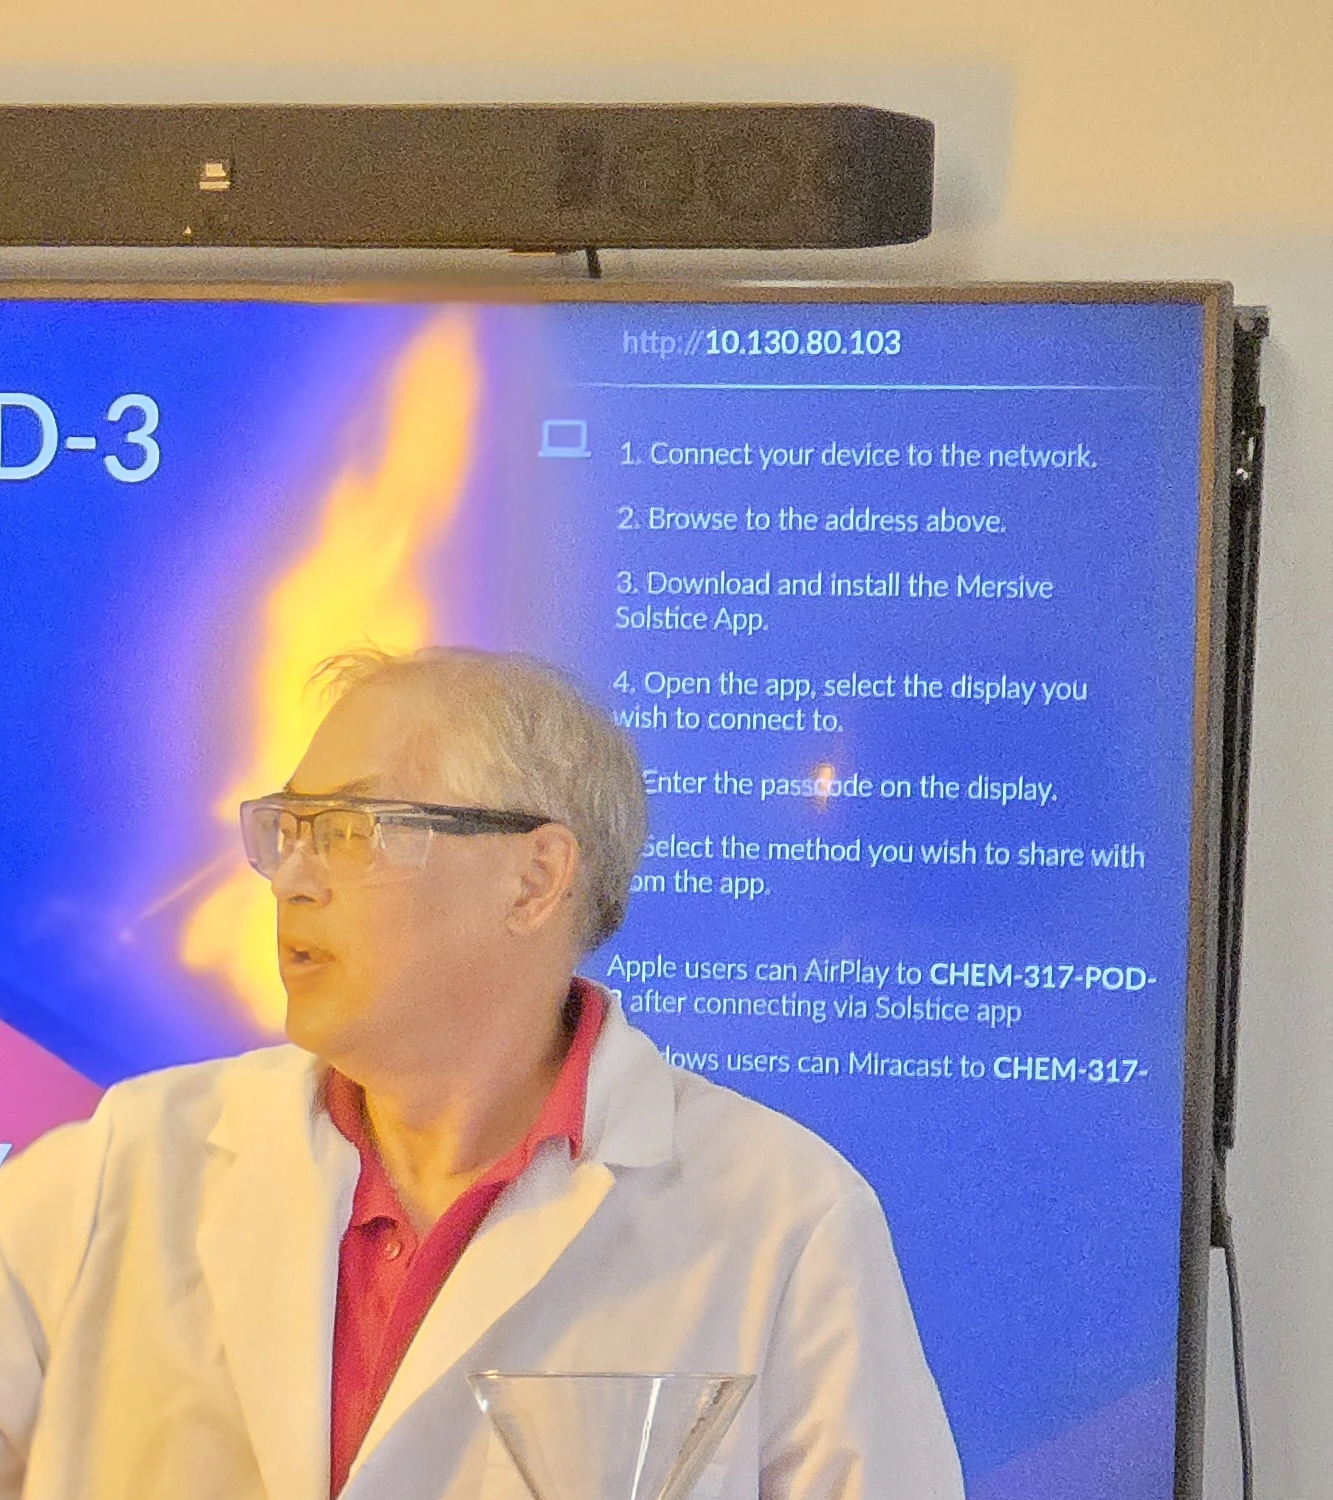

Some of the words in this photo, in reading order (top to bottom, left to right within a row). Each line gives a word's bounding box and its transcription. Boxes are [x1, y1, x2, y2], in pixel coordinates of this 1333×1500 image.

[620, 441, 642, 465] 1.
[649, 441, 753, 466] Connect
[759, 447, 816, 471] your
[820, 441, 900, 467] device
[907, 442, 933, 467] to
[940, 442, 982, 467] the
[988, 443, 1097, 468] network.
[617, 505, 640, 530] 2.
[648, 506, 738, 531] Browse
[745, 507, 771, 531] to
[778, 506, 819, 531] the
[824, 506, 919, 533] address
[925, 507, 1006, 533] above.
[616, 570, 639, 594] 3.
[647, 570, 771, 596] Download
[777, 571, 823, 596] and
[830, 571, 900, 597] install
[907, 572, 949, 598] the
[956, 573, 1054, 599] Mersive
[615, 604, 708, 630] Solstice
[713, 606, 769, 636] App.
[612, 670, 636, 694] 4.
[643, 670, 711, 699] Open
[718, 670, 758, 696] the
[765, 678, 816, 702] app,
[823, 671, 896, 698] select
[903, 673, 943, 698] the
[950, 673, 1037, 705] display
[1041, 680, 1088, 706] you
[614, 707, 668, 730] wish
[675, 706, 700, 730] to
[707, 708, 805, 731] connect
[812, 708, 844, 732] to.
[642, 770, 708, 794] Enter
[713, 770, 754, 795] the
[761, 774, 873, 800] passcode
[880, 779, 912, 798] on
[919, 774, 960, 799] the
[967, 774, 1057, 806] display.
[720, 834, 761, 860] the
[768, 836, 861, 862] method
[867, 844, 914, 868] you
[920, 839, 977, 865] wish
[984, 842, 1010, 866] to
[1017, 840, 1085, 867] share
[1090, 842, 1145, 869] with
[673, 868, 713, 894] the
[719, 876, 770, 901] app.
[606, 953, 677, 984] Apple
[684, 961, 748, 981] users
[755, 963, 797, 982] can
[803, 958, 890, 990] AirPlay
[896, 961, 922, 985] to
[929, 962, 1157, 991] CHEM-317-POD-
[629, 987, 688, 1014] after
[693, 992, 827, 1024] connecting
[833, 994, 867, 1019] via
[875, 994, 970, 1021] Solstice
[976, 1003, 1022, 1029] app
[726, 1053, 791, 1073] users
[797, 1056, 840, 1075] can
[848, 1050, 953, 1078] Miracast
[959, 1055, 986, 1079] to
[993, 1055, 1148, 1083] CHEM-317-
